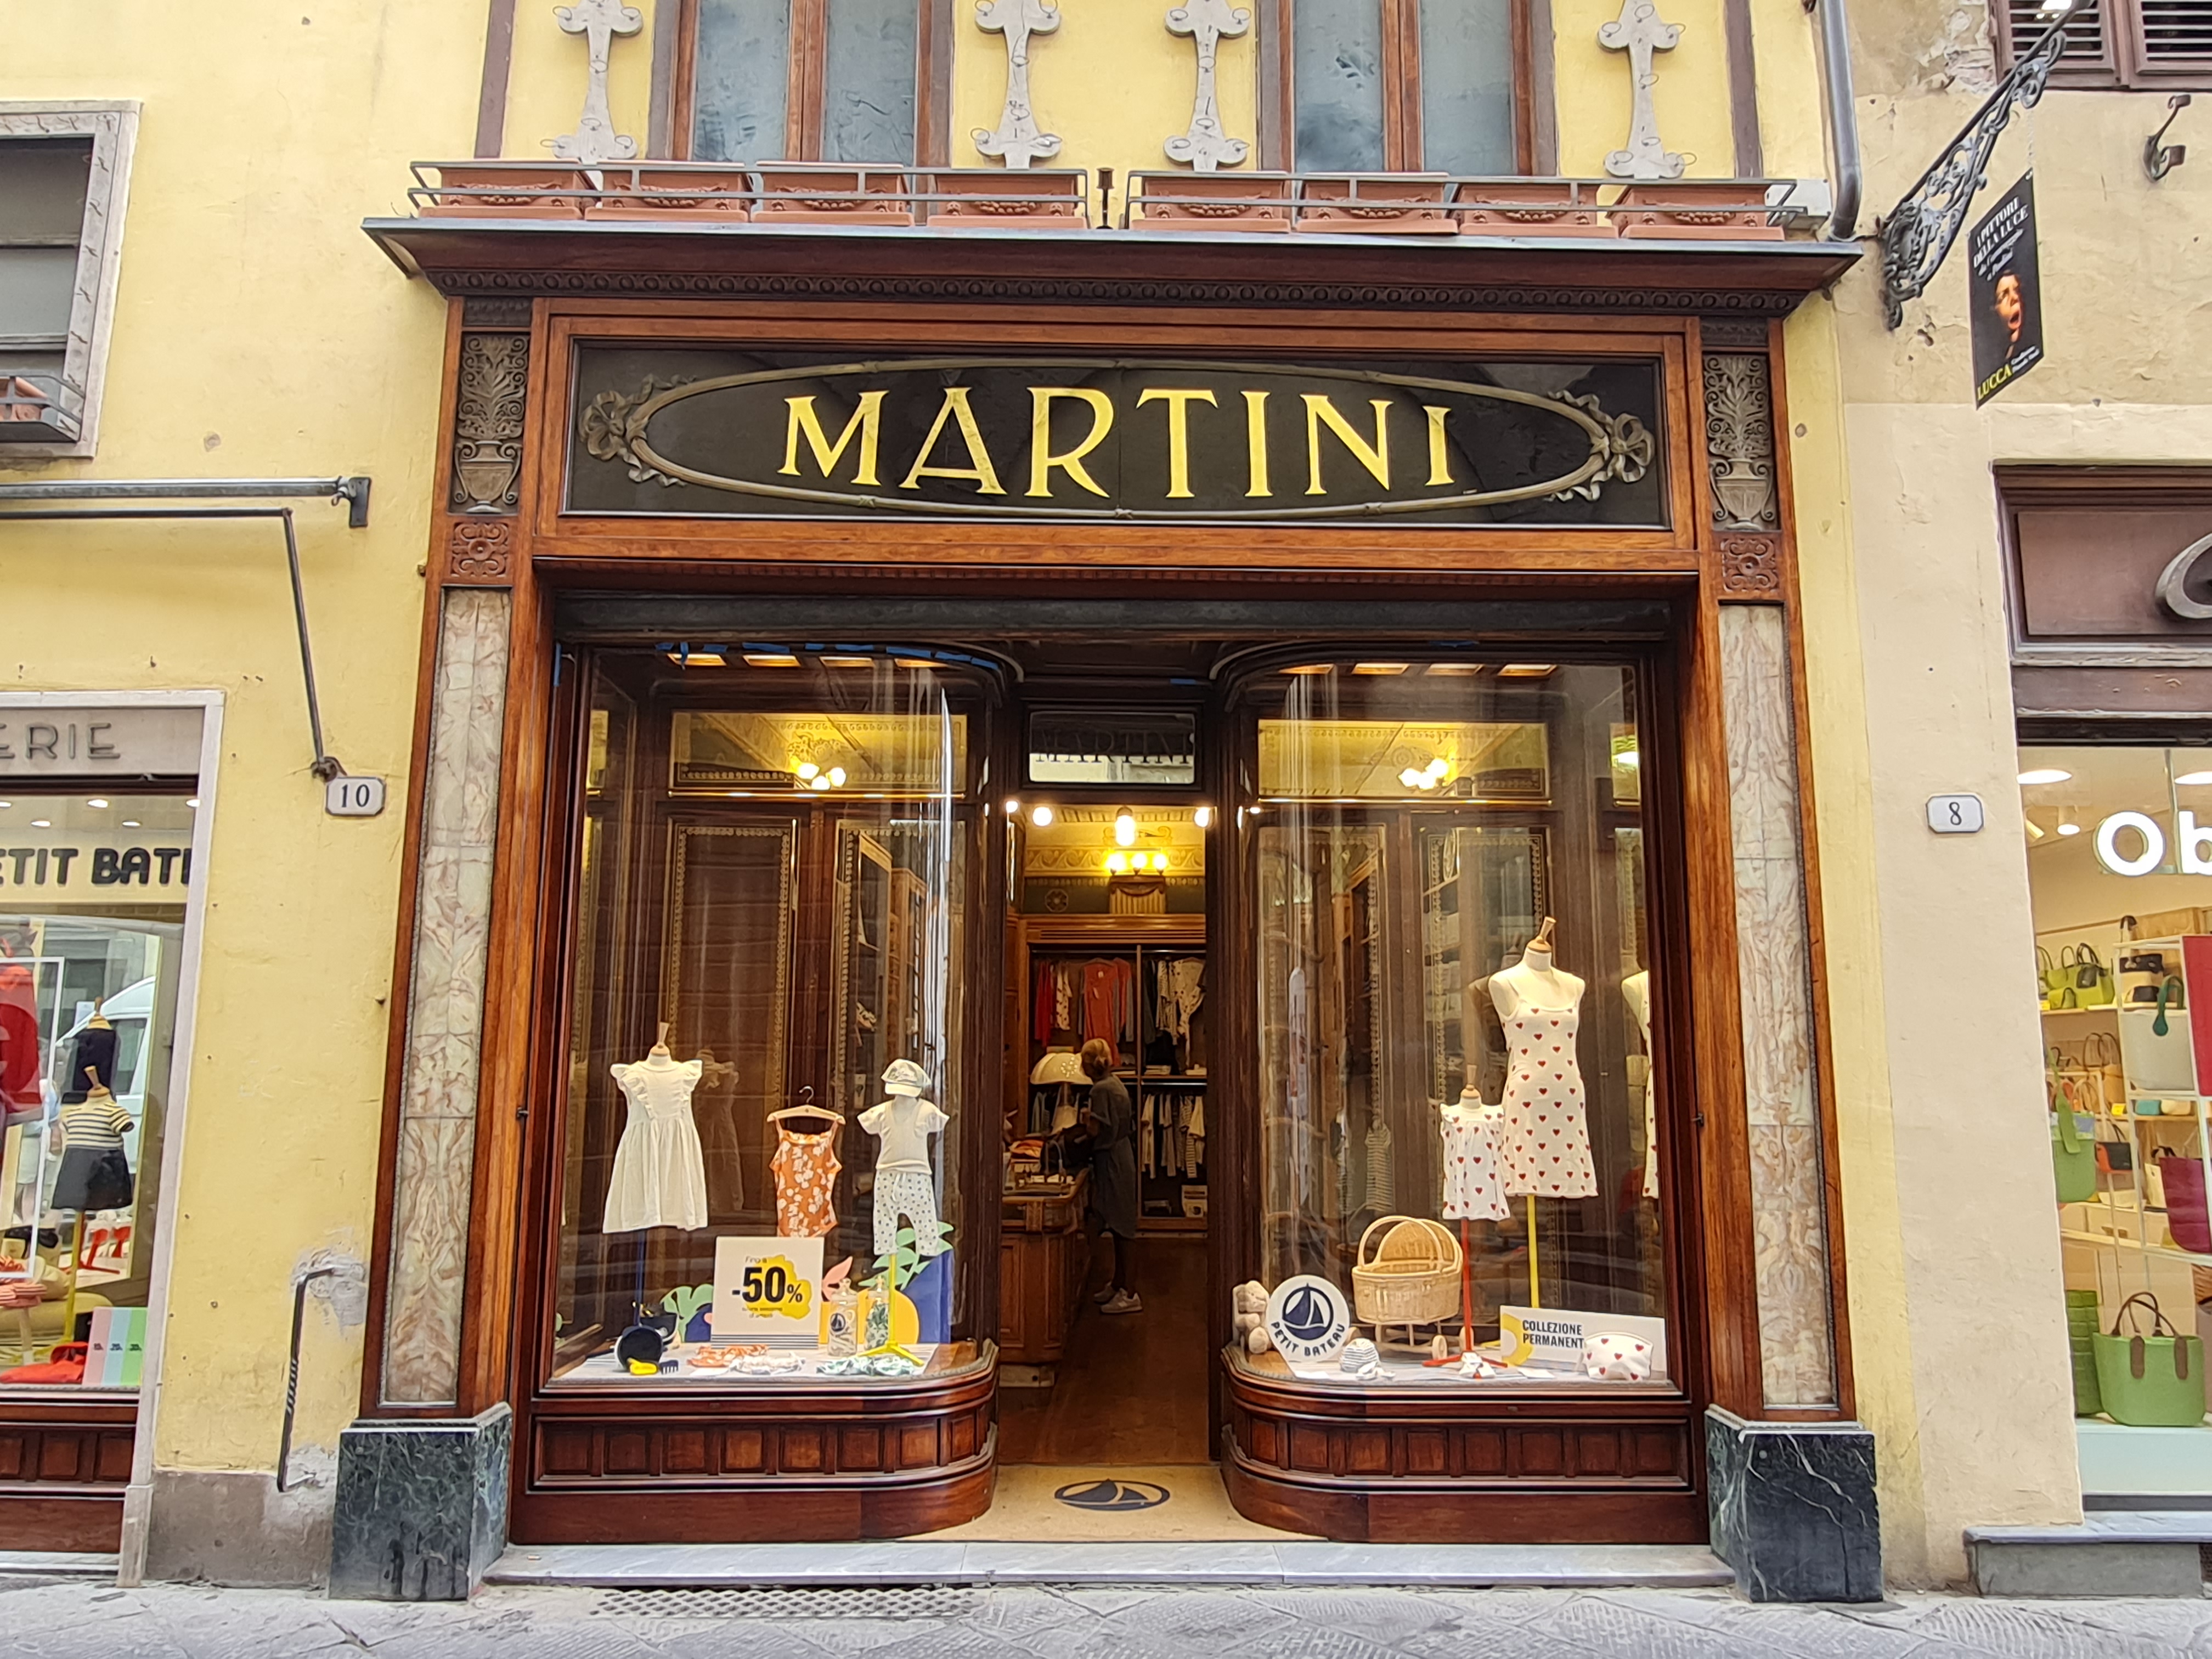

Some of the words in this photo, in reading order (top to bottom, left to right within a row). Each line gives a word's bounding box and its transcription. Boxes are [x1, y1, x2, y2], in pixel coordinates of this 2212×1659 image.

[1980, 196, 2020, 242] PITTORI
[2000, 204, 2029, 239] LUCE
[1977, 363, 2012, 401] LUCCA
[777, 386, 1455, 499] MARTINI
[1035, 729, 1190, 759] MARTINI
[341, 784, 370, 808] 10
[1949, 802, 1962, 826] 8
[0, 848, 78, 885] TIT
[732, 1266, 803, 1304] -50%
[1271, 1321, 1299, 1353] PETIT
[1304, 1323, 1346, 1357] BATEAU
[1522, 1319, 1582, 1335] COLLEZIONE
[1523, 1333, 1585, 1349] PERMANENT
